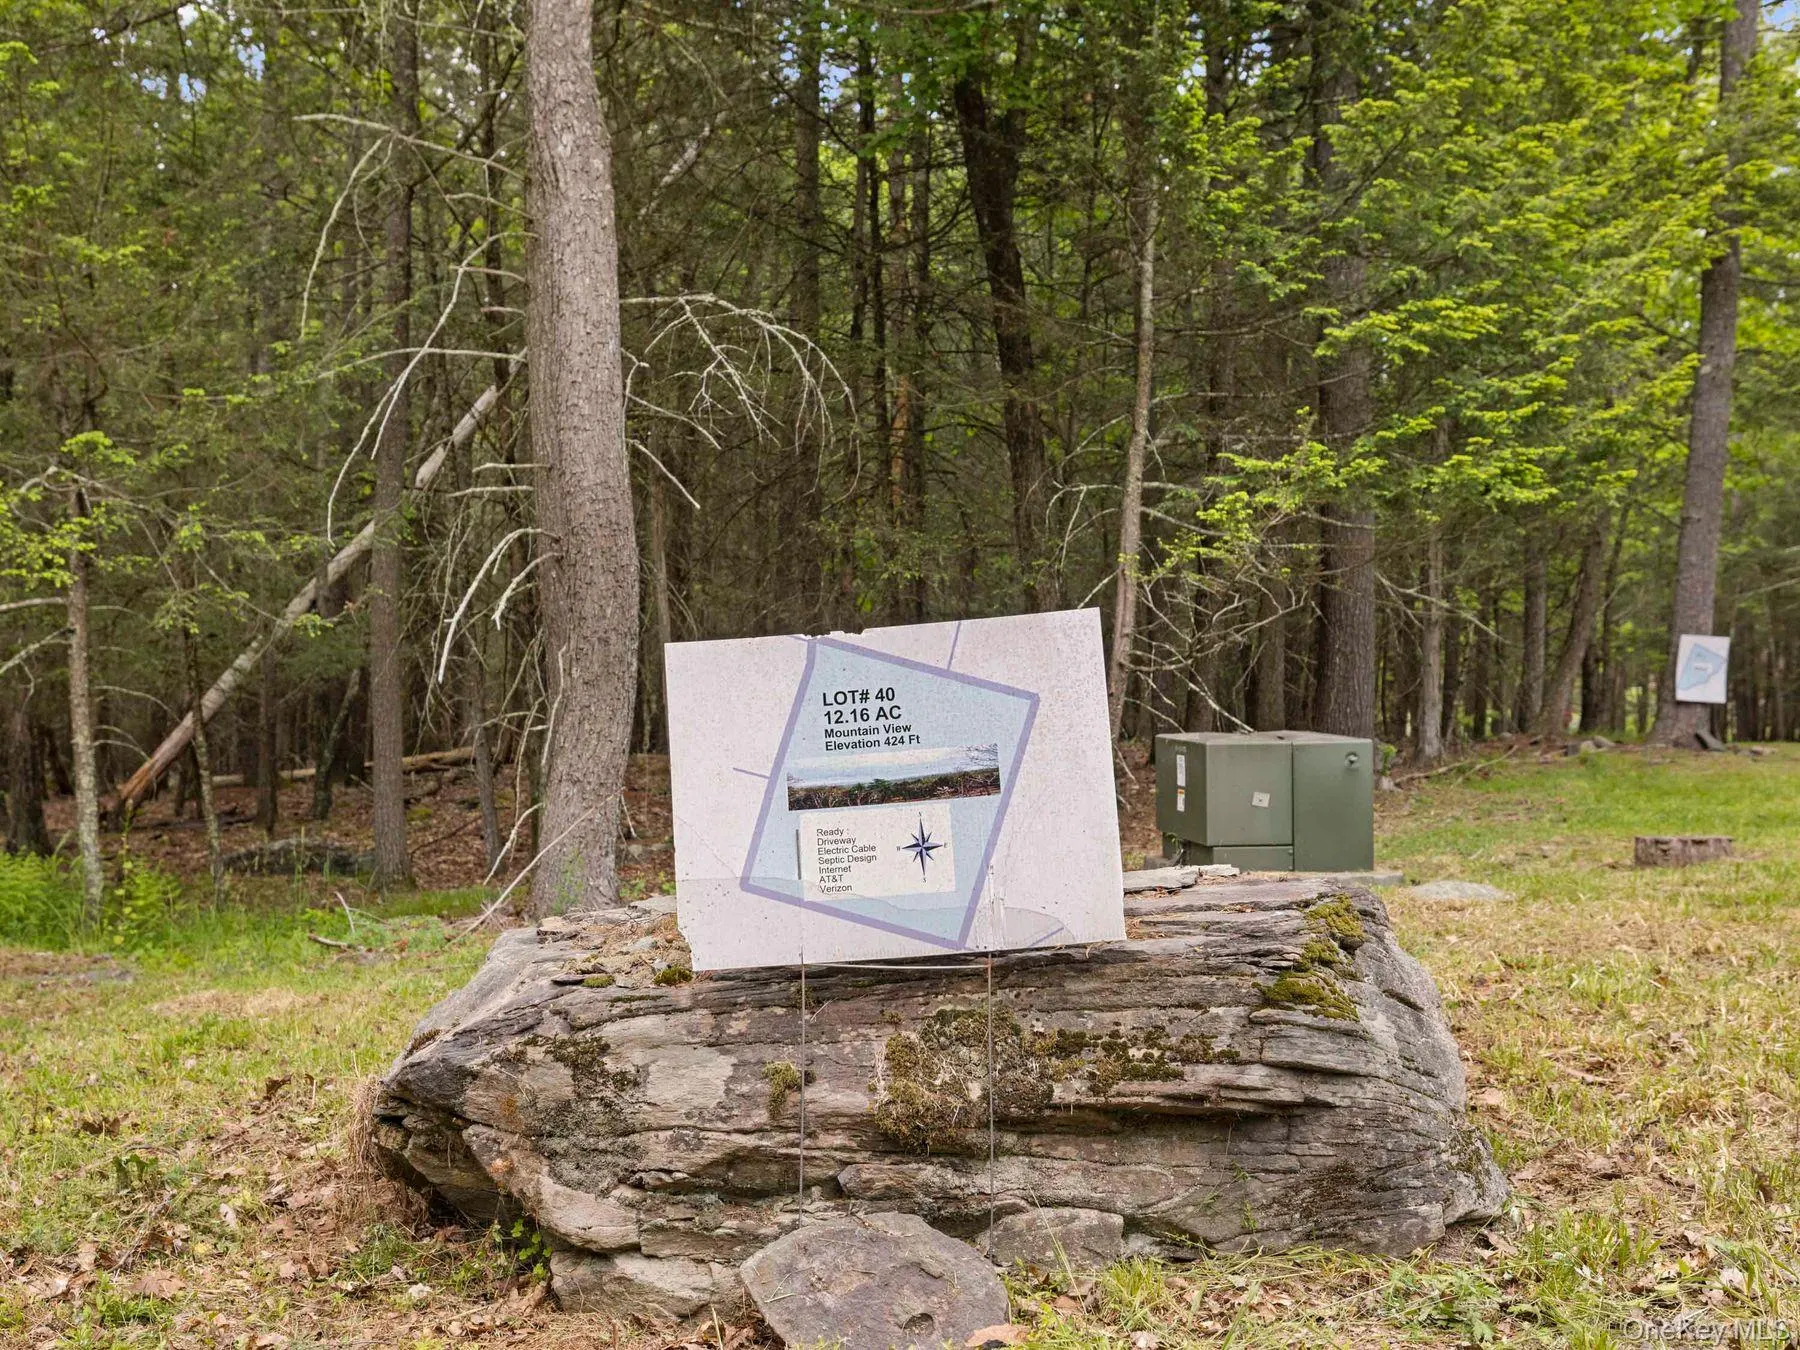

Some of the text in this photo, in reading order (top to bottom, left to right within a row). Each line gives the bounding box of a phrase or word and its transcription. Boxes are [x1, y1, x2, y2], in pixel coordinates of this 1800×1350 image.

[822, 687, 896, 707] LOT# 40
[824, 705, 902, 725] 12.16 AC
[824, 723, 912, 739] Mountain View
[825, 734, 921, 751] Elevation 424 Ft
[817, 838, 857, 846] Driveway
[817, 845, 877, 856] Electric Cable
[818, 854, 877, 865] Septic Design
[818, 865, 852, 874] Internet
[819, 874, 843, 883] AT&T
[819, 885, 853, 893] Verizon
